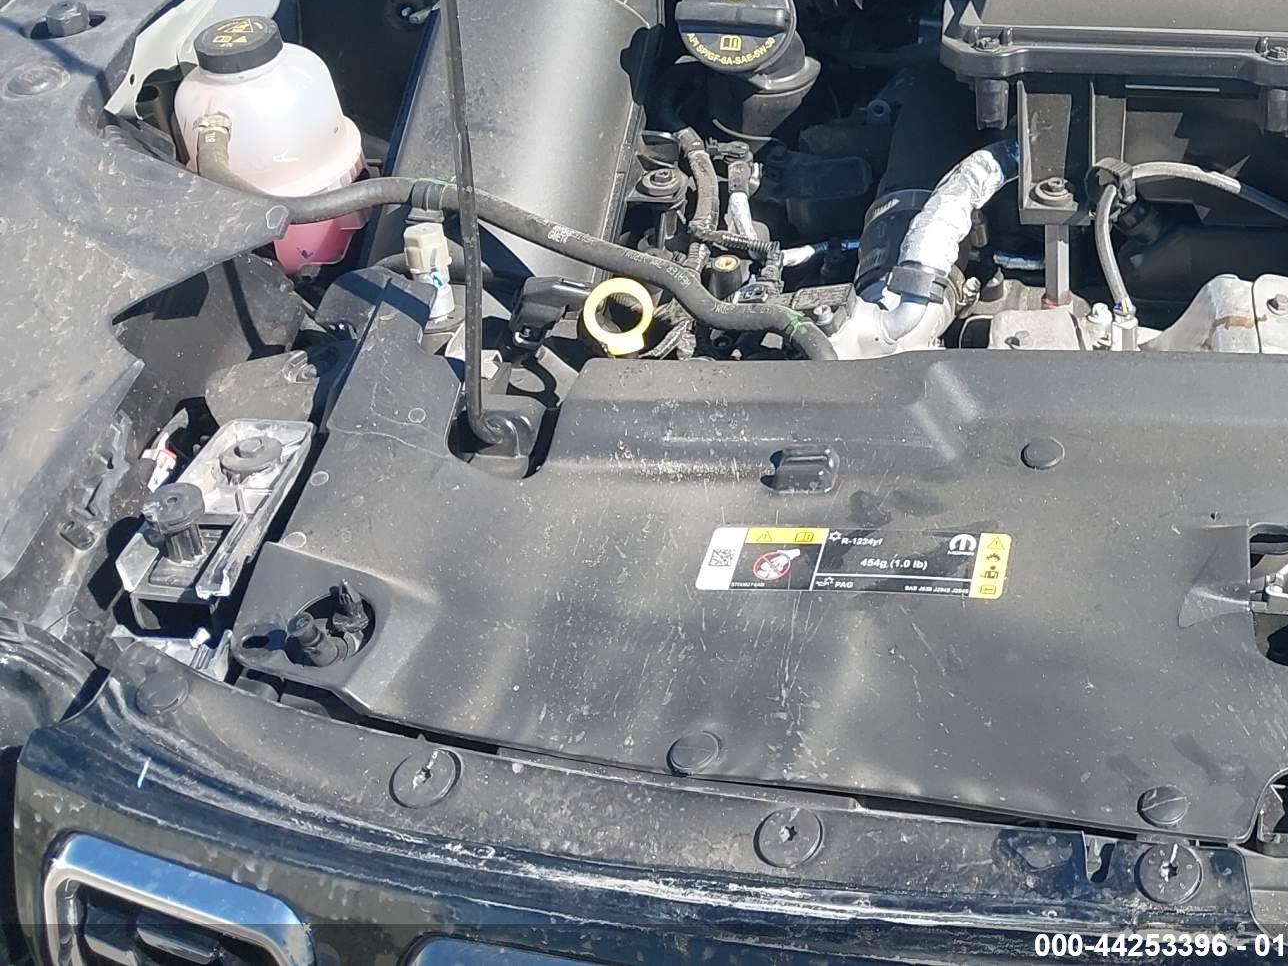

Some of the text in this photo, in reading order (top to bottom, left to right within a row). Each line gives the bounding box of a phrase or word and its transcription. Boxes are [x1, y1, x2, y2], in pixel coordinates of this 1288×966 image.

[687, 33, 699, 47] API
[841, 537, 884, 547] R-1234yf
[860, 558, 928, 570] 454g (1.0 lb)
